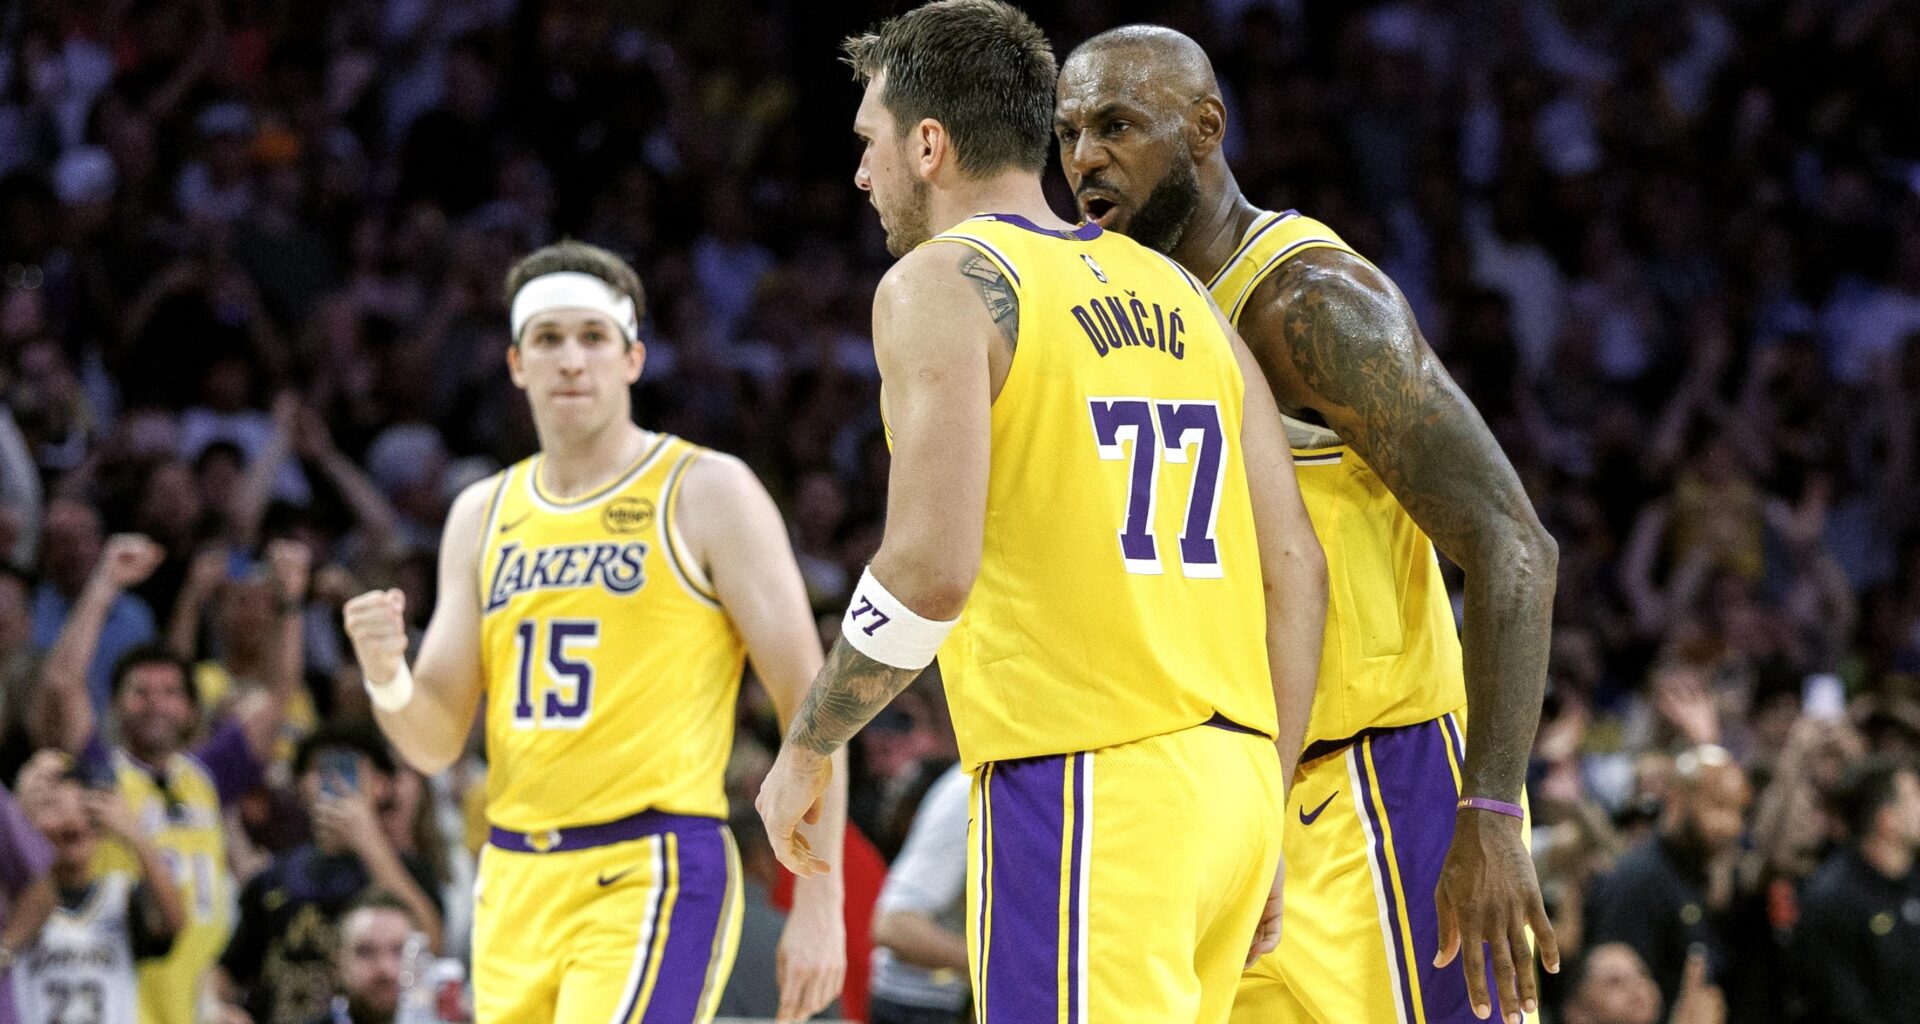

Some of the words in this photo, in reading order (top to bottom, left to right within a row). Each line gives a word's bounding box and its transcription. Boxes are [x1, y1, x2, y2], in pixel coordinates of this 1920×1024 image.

[1071, 289, 1185, 360] DONČIĆ
[1087, 396, 1228, 579] 77
[485, 542, 648, 612] LAKERS
[851, 594, 890, 637] 77
[514, 620, 597, 726] 15
